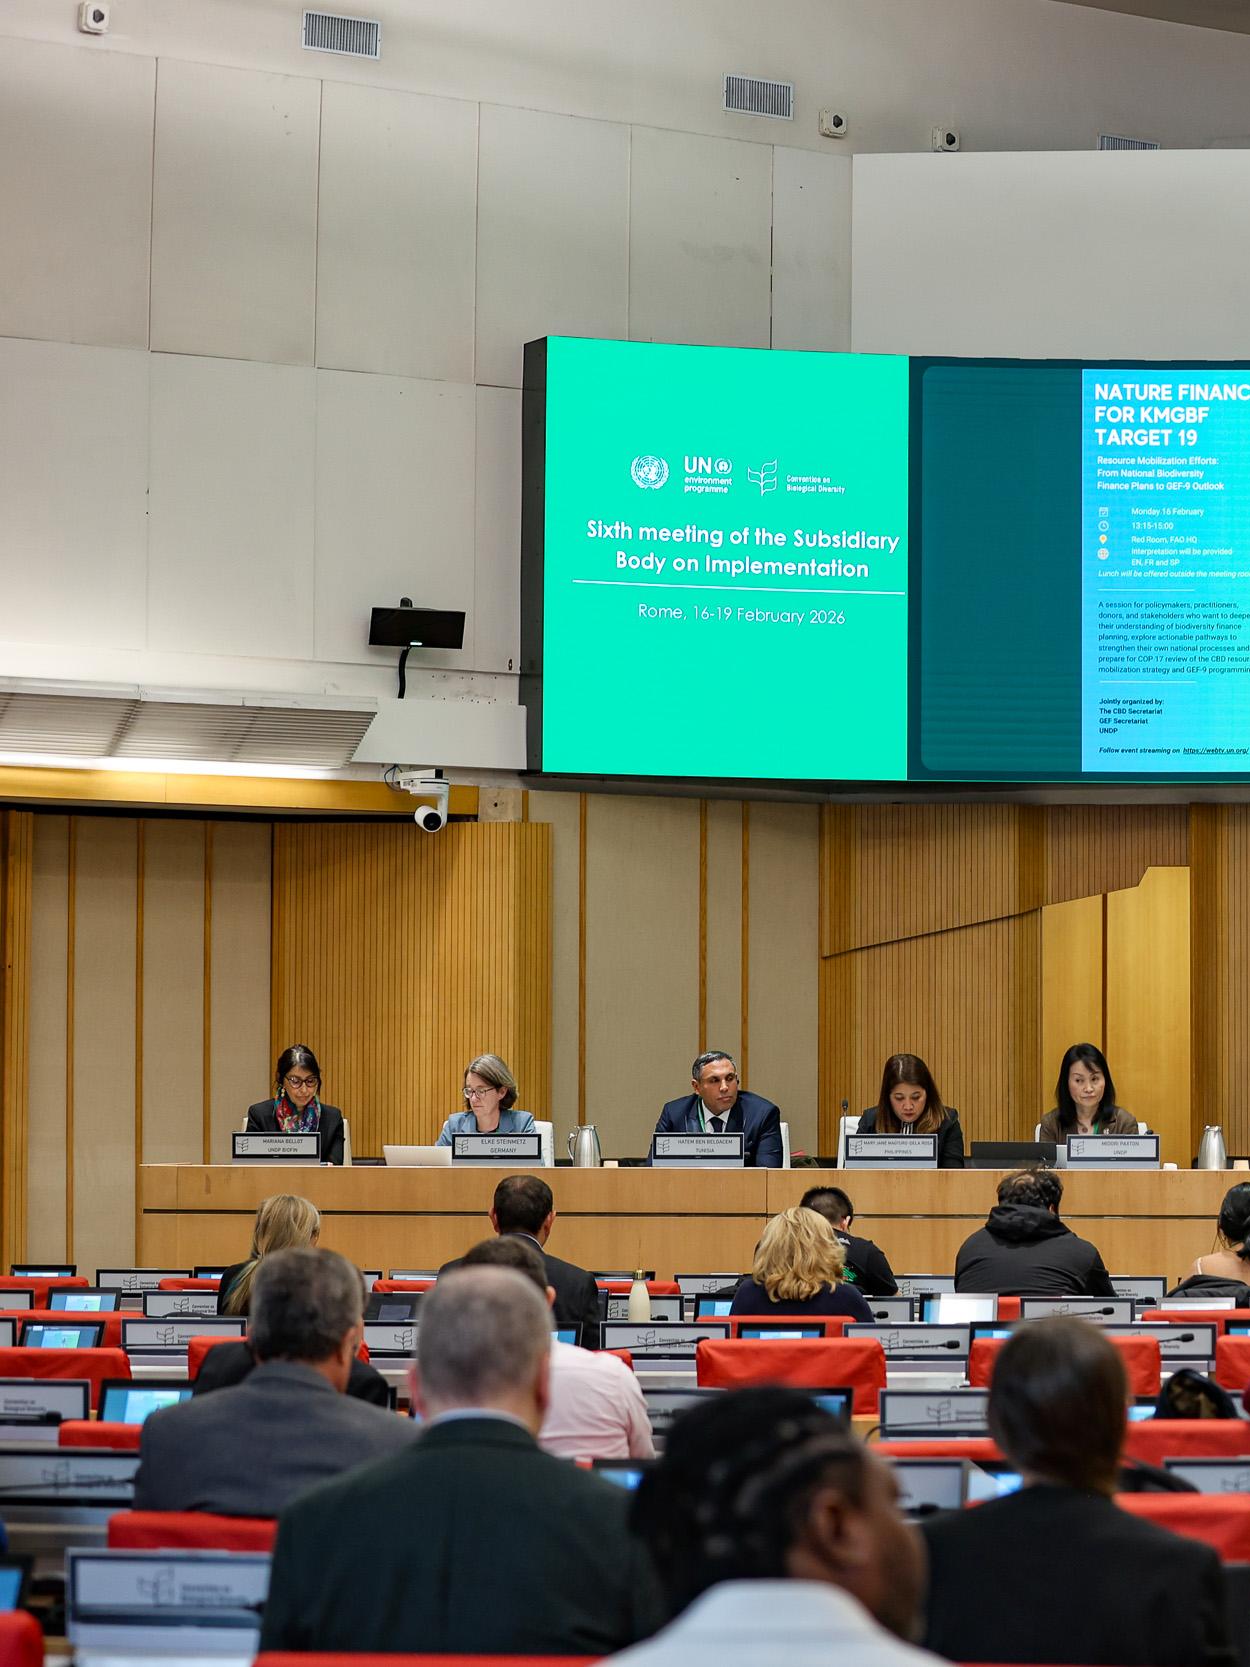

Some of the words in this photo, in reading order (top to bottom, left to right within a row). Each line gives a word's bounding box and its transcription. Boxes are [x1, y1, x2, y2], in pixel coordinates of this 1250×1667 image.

[1095, 383, 1172, 401] NATURE
[1095, 406, 1135, 423] FOR
[1140, 406, 1209, 423] KMGBF
[1095, 429, 1172, 446] TARGET
[1178, 429, 1198, 446] 19
[684, 456, 712, 474] UN
[1097, 456, 1136, 465] Resource
[1137, 456, 1187, 465] Mobilization
[1189, 456, 1219, 465] Efforts:
[1097, 469, 1119, 478] From
[1120, 469, 1155, 478] National
[1156, 469, 1204, 479] Biodiversity
[684, 476, 733, 486] environment
[786, 475, 822, 484] Convention
[684, 485, 729, 494] programme
[786, 484, 817, 493] Biological
[818, 485, 846, 495] Diversity
[1097, 482, 1129, 490] Finance
[1131, 482, 1154, 490] Plans
[1166, 482, 1191, 490] GEF-9
[1192, 482, 1225, 490] Outlook
[1131, 508, 1161, 517] Monday
[1173, 508, 1204, 517] February
[586, 519, 633, 540] Sixth
[638, 522, 724, 547] meeting
[730, 526, 750, 545] of
[754, 527, 787, 547] the
[793, 530, 900, 554] Subsidiary
[1146, 536, 1169, 544] Room,
[1186, 536, 1198, 544] HQ
[616, 551, 667, 574] Body
[672, 557, 699, 572] on
[705, 556, 869, 578] Implementation
[1144, 601, 1193, 609] policymakers,
[1193, 601, 1239, 609] practitioners,
[638, 603, 687, 621] Rome,
[693, 605, 733, 621] 16-19
[737, 607, 805, 626] February
[809, 609, 846, 625] 2026
[1098, 612, 1124, 620] donors,
[1115, 623, 1165, 631] understanding
[1175, 623, 1215, 631] biodiversity
[1098, 666, 1141, 674] mobilization
[1142, 666, 1170, 675] strategy
[1172, 666, 1185, 674] and
[1186, 666, 1207, 674] GEF-9
